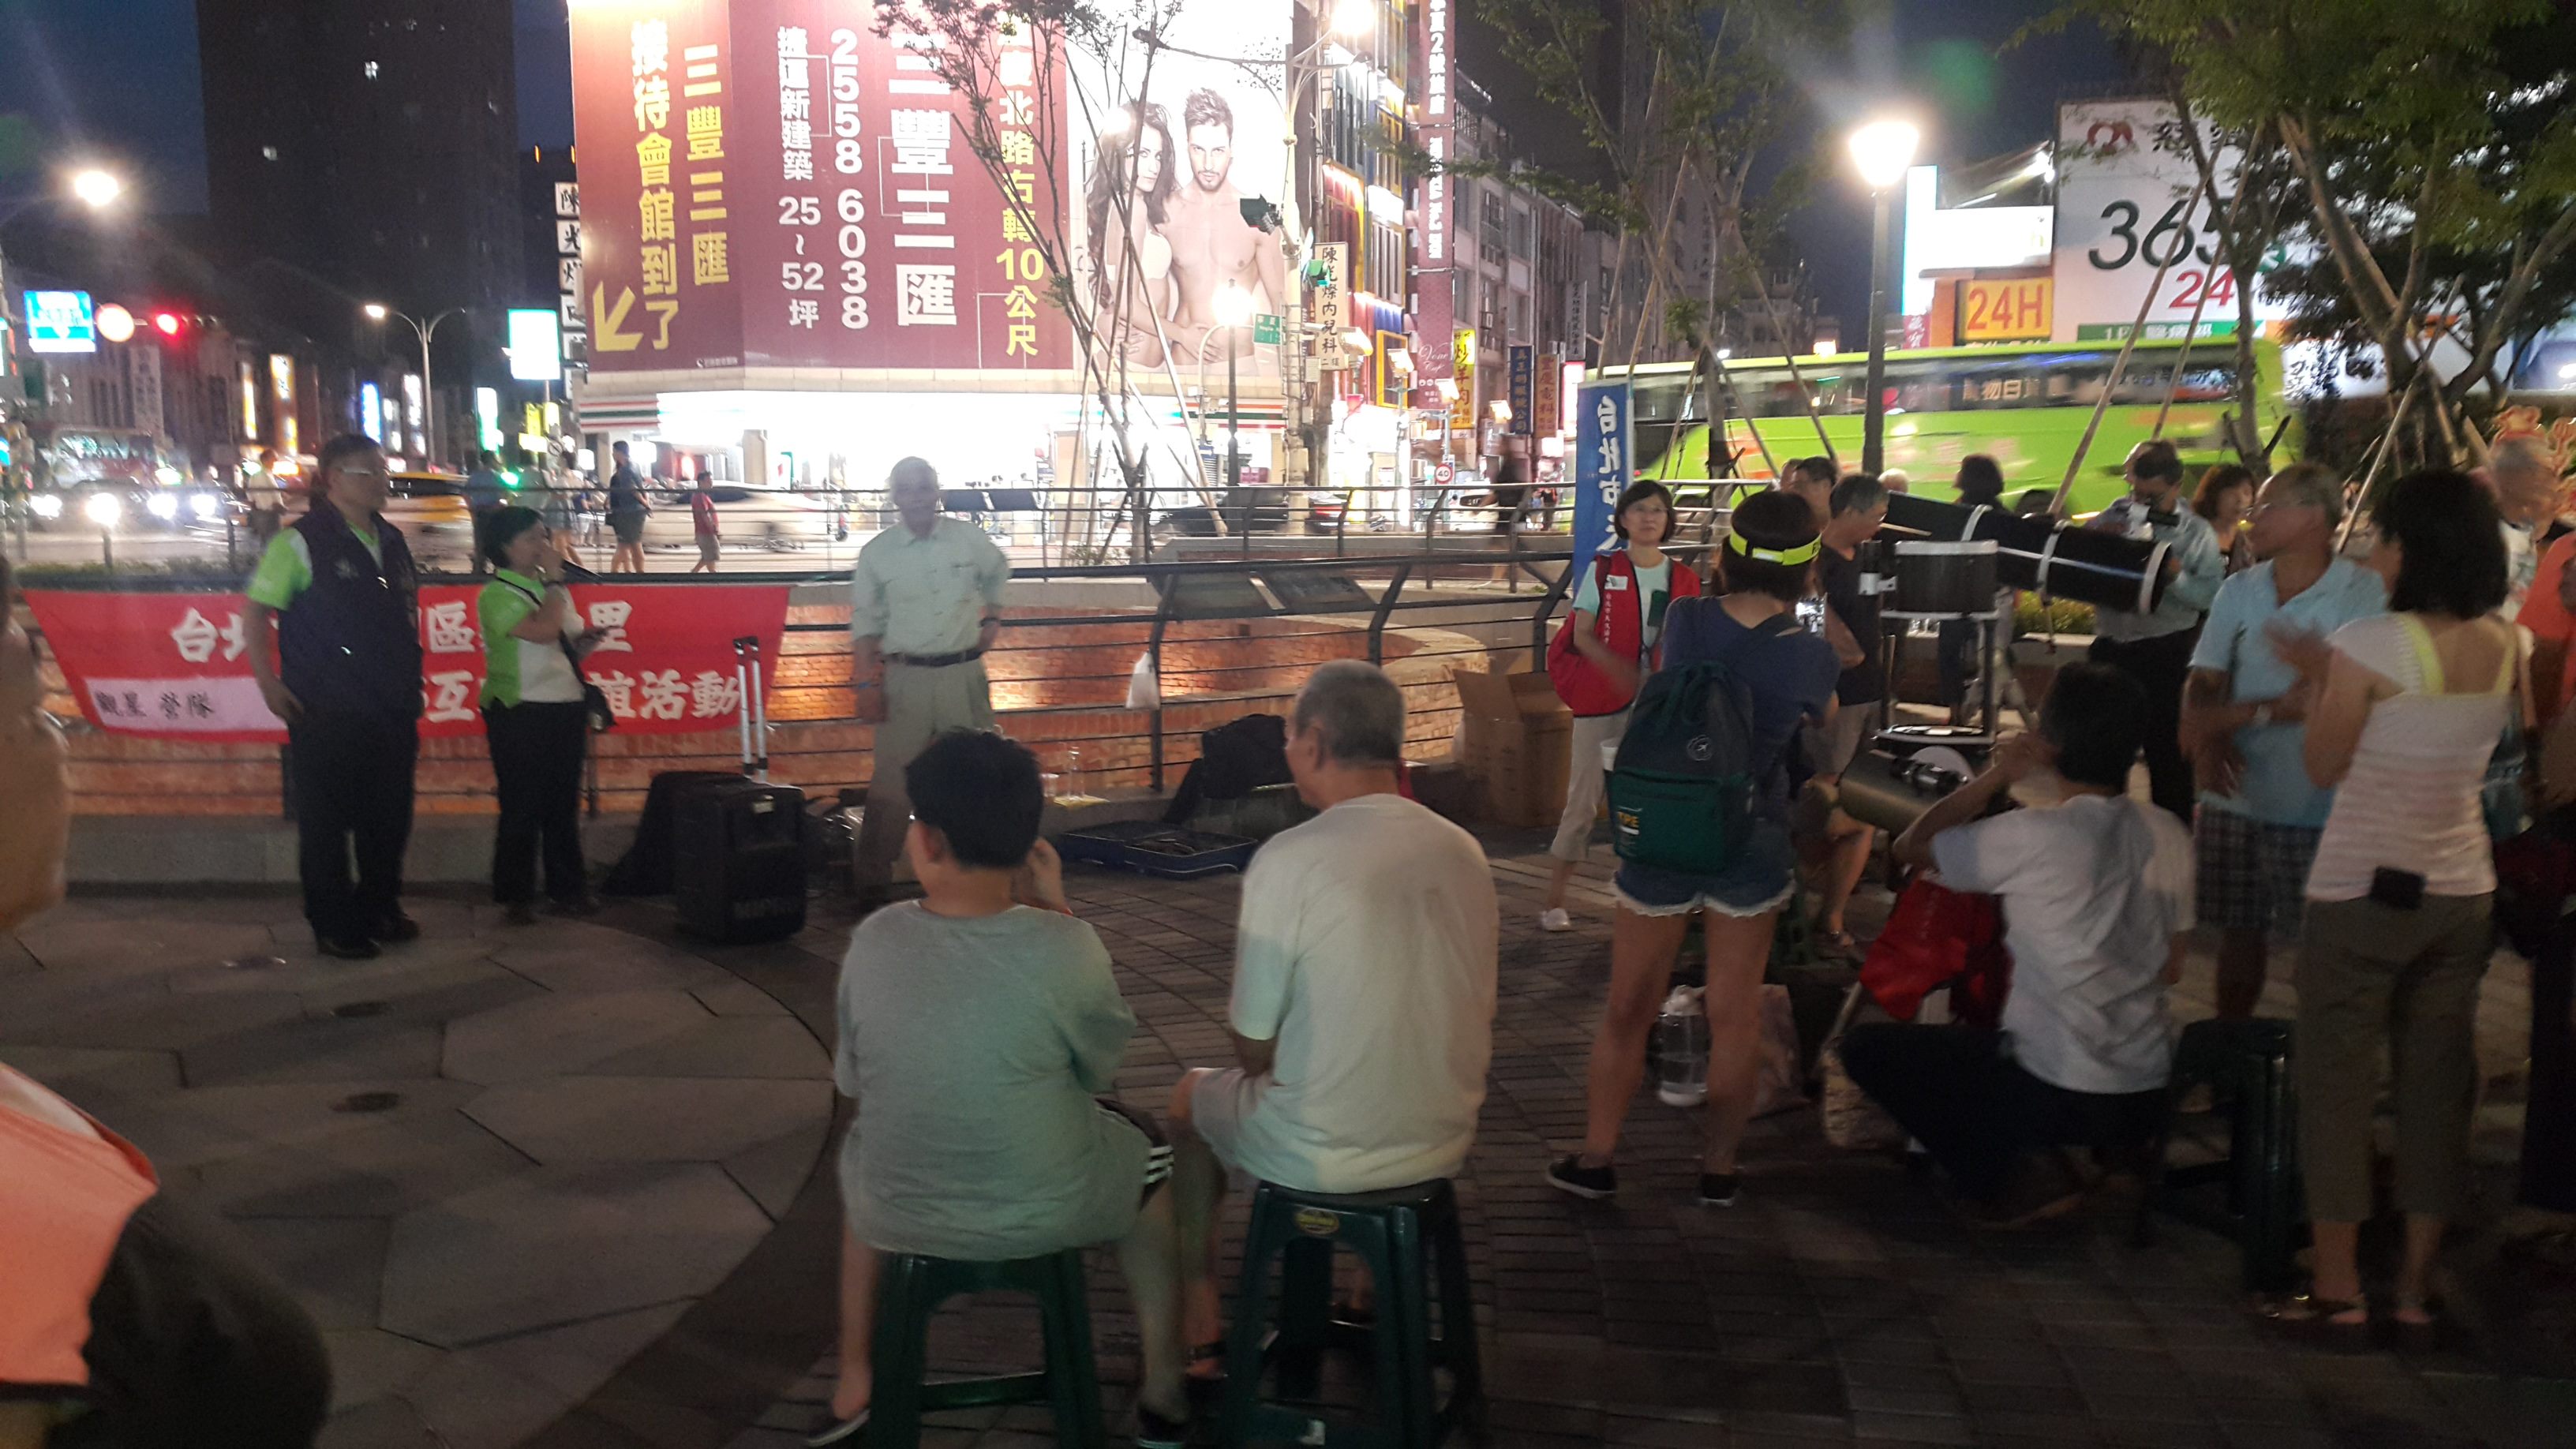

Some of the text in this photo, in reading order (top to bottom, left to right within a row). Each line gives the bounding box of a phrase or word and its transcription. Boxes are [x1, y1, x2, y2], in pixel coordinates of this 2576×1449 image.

[631, 17, 679, 350] 接待會館到了
[683, 43, 730, 286] 三豐三匯
[889, 33, 957, 326] 三豐三匯
[1967, 284, 2044, 331] 24H
